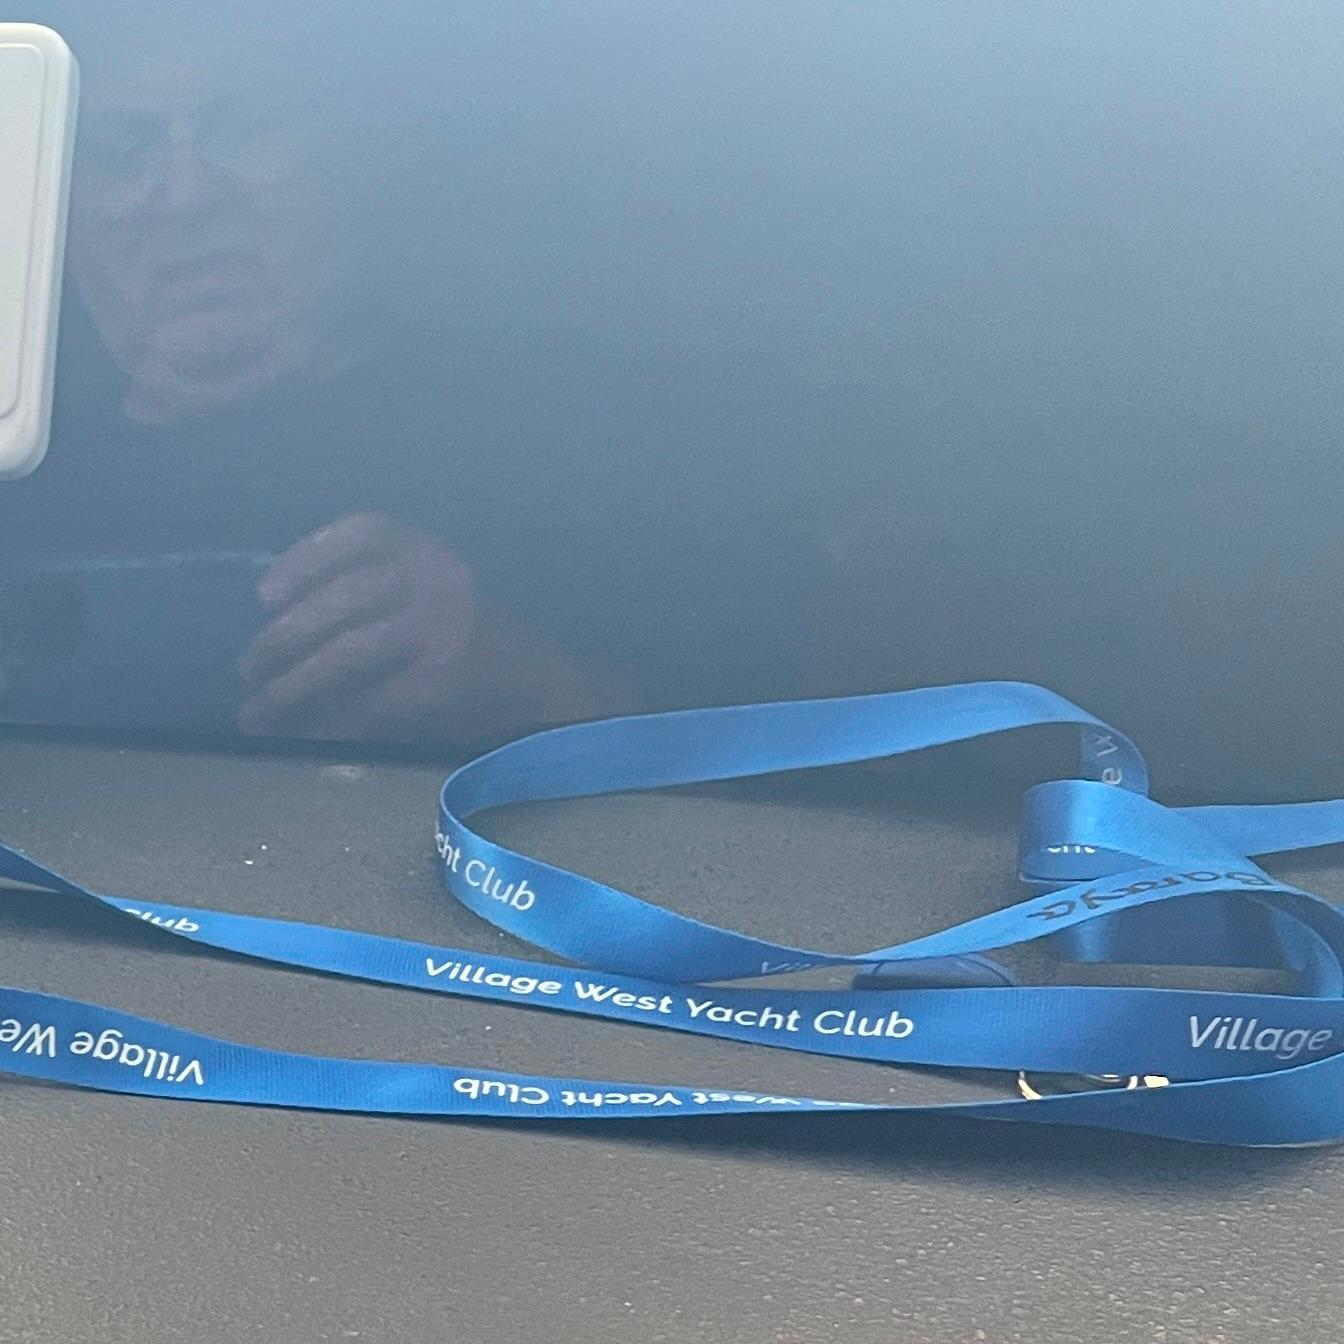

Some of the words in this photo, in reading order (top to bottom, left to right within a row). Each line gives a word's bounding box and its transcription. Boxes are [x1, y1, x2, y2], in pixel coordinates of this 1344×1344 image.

[465, 859, 536, 911] Club
[425, 958, 562, 995] Village
[574, 981, 672, 1014] West
[686, 998, 801, 1032] Yacht
[813, 1010, 915, 1039] Club
[69, 1029, 205, 1086] Village
[1189, 1016, 1334, 1061] Village
[453, 1077, 547, 1105] Club
[562, 1090, 683, 1108] Yacht
